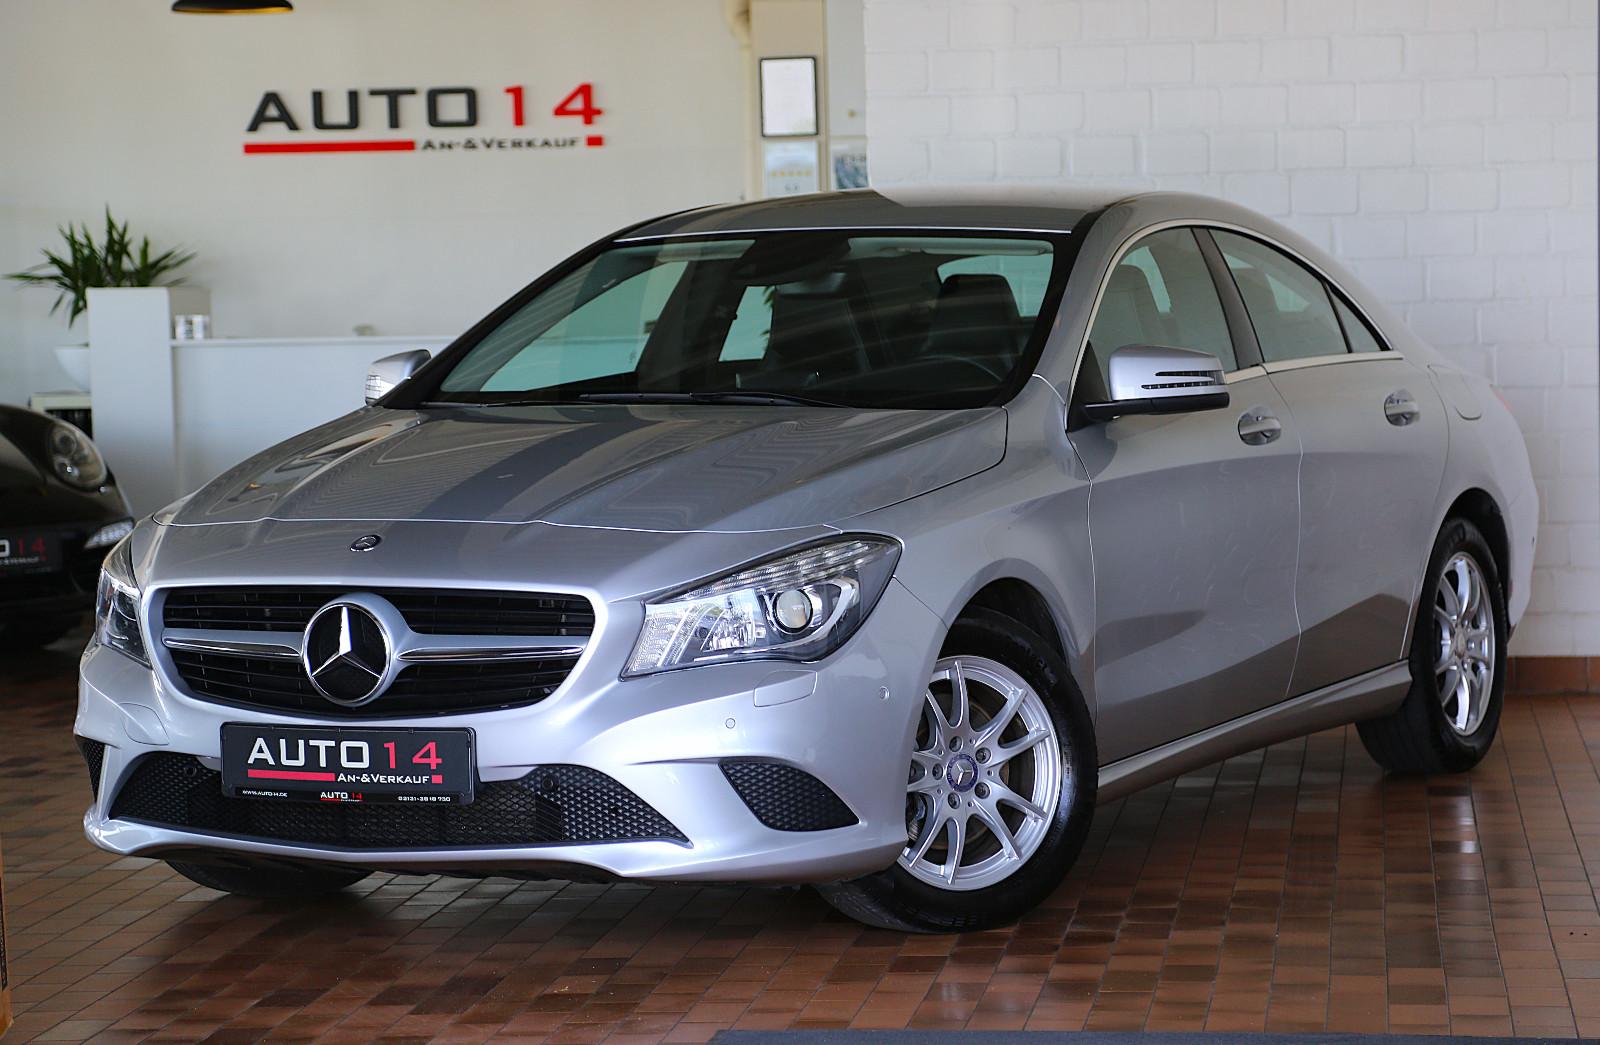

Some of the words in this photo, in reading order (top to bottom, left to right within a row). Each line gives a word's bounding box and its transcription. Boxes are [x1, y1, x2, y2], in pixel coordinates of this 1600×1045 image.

[246, 87, 478, 132] AUTO
[247, 737, 370, 769] AUTO
[320, 791, 348, 799] AUTO
